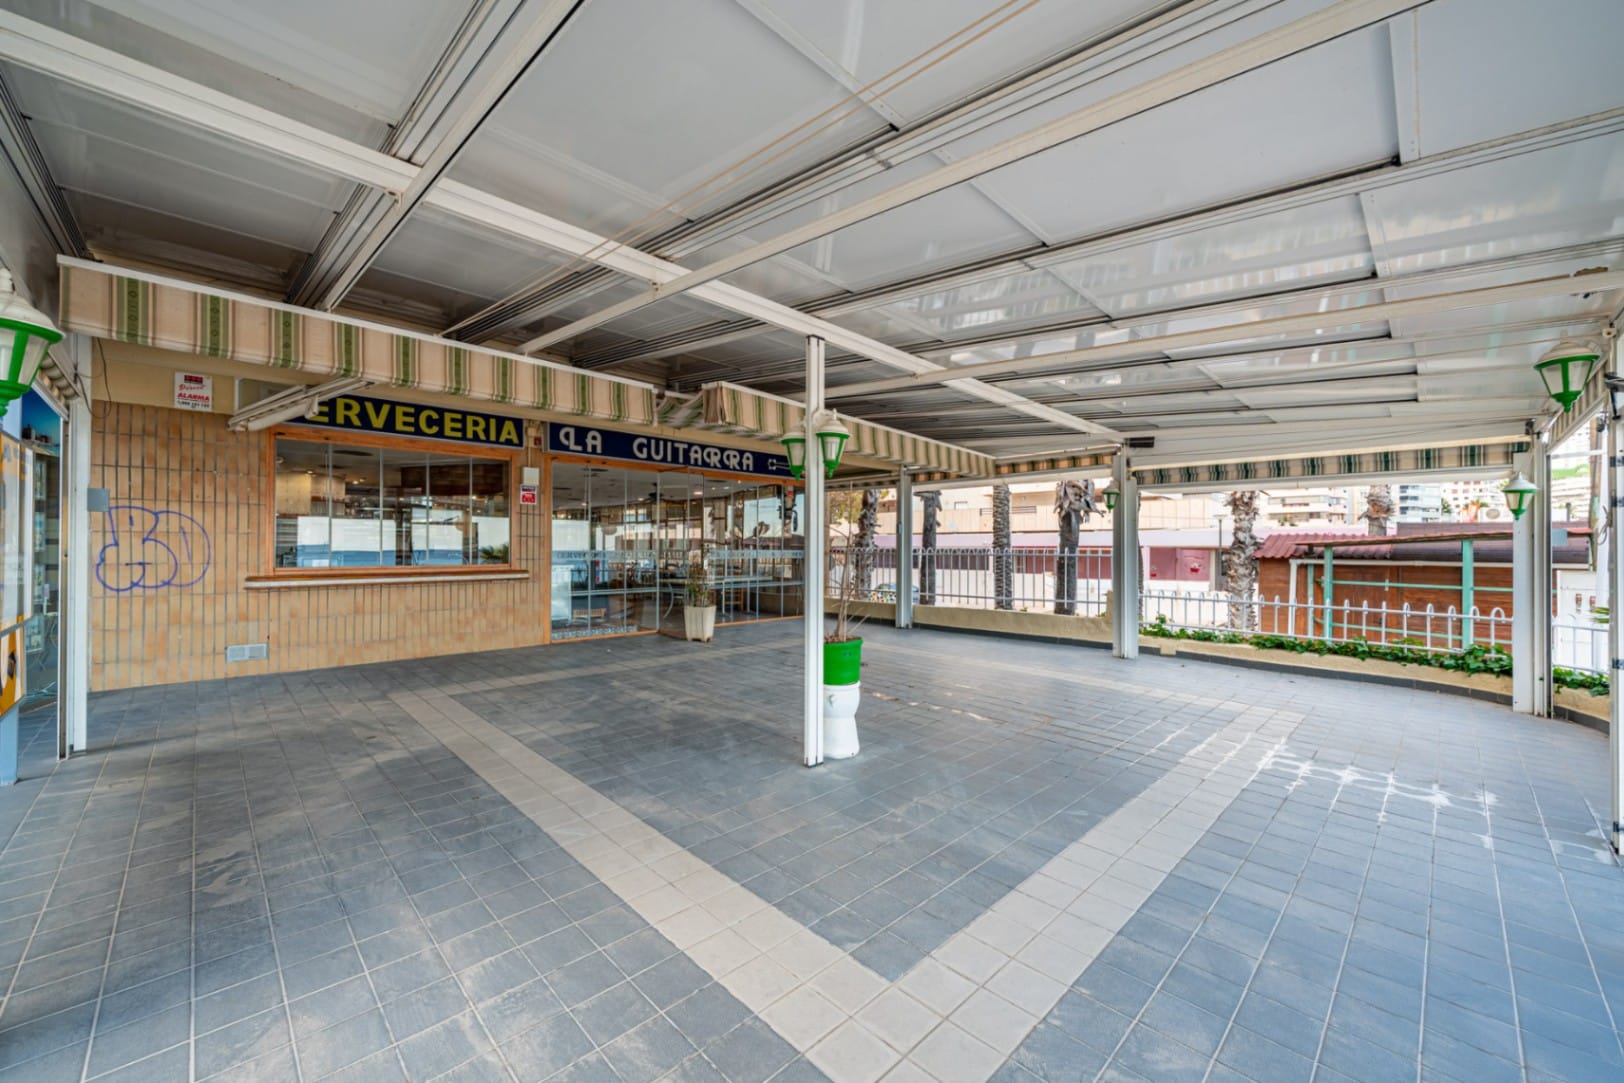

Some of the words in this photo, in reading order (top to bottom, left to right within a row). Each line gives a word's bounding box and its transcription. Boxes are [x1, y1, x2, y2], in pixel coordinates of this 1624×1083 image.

[308, 397, 519, 445] ERVECERIA
[559, 426, 602, 454] LA
[632, 438, 754, 472] GUITARRA
